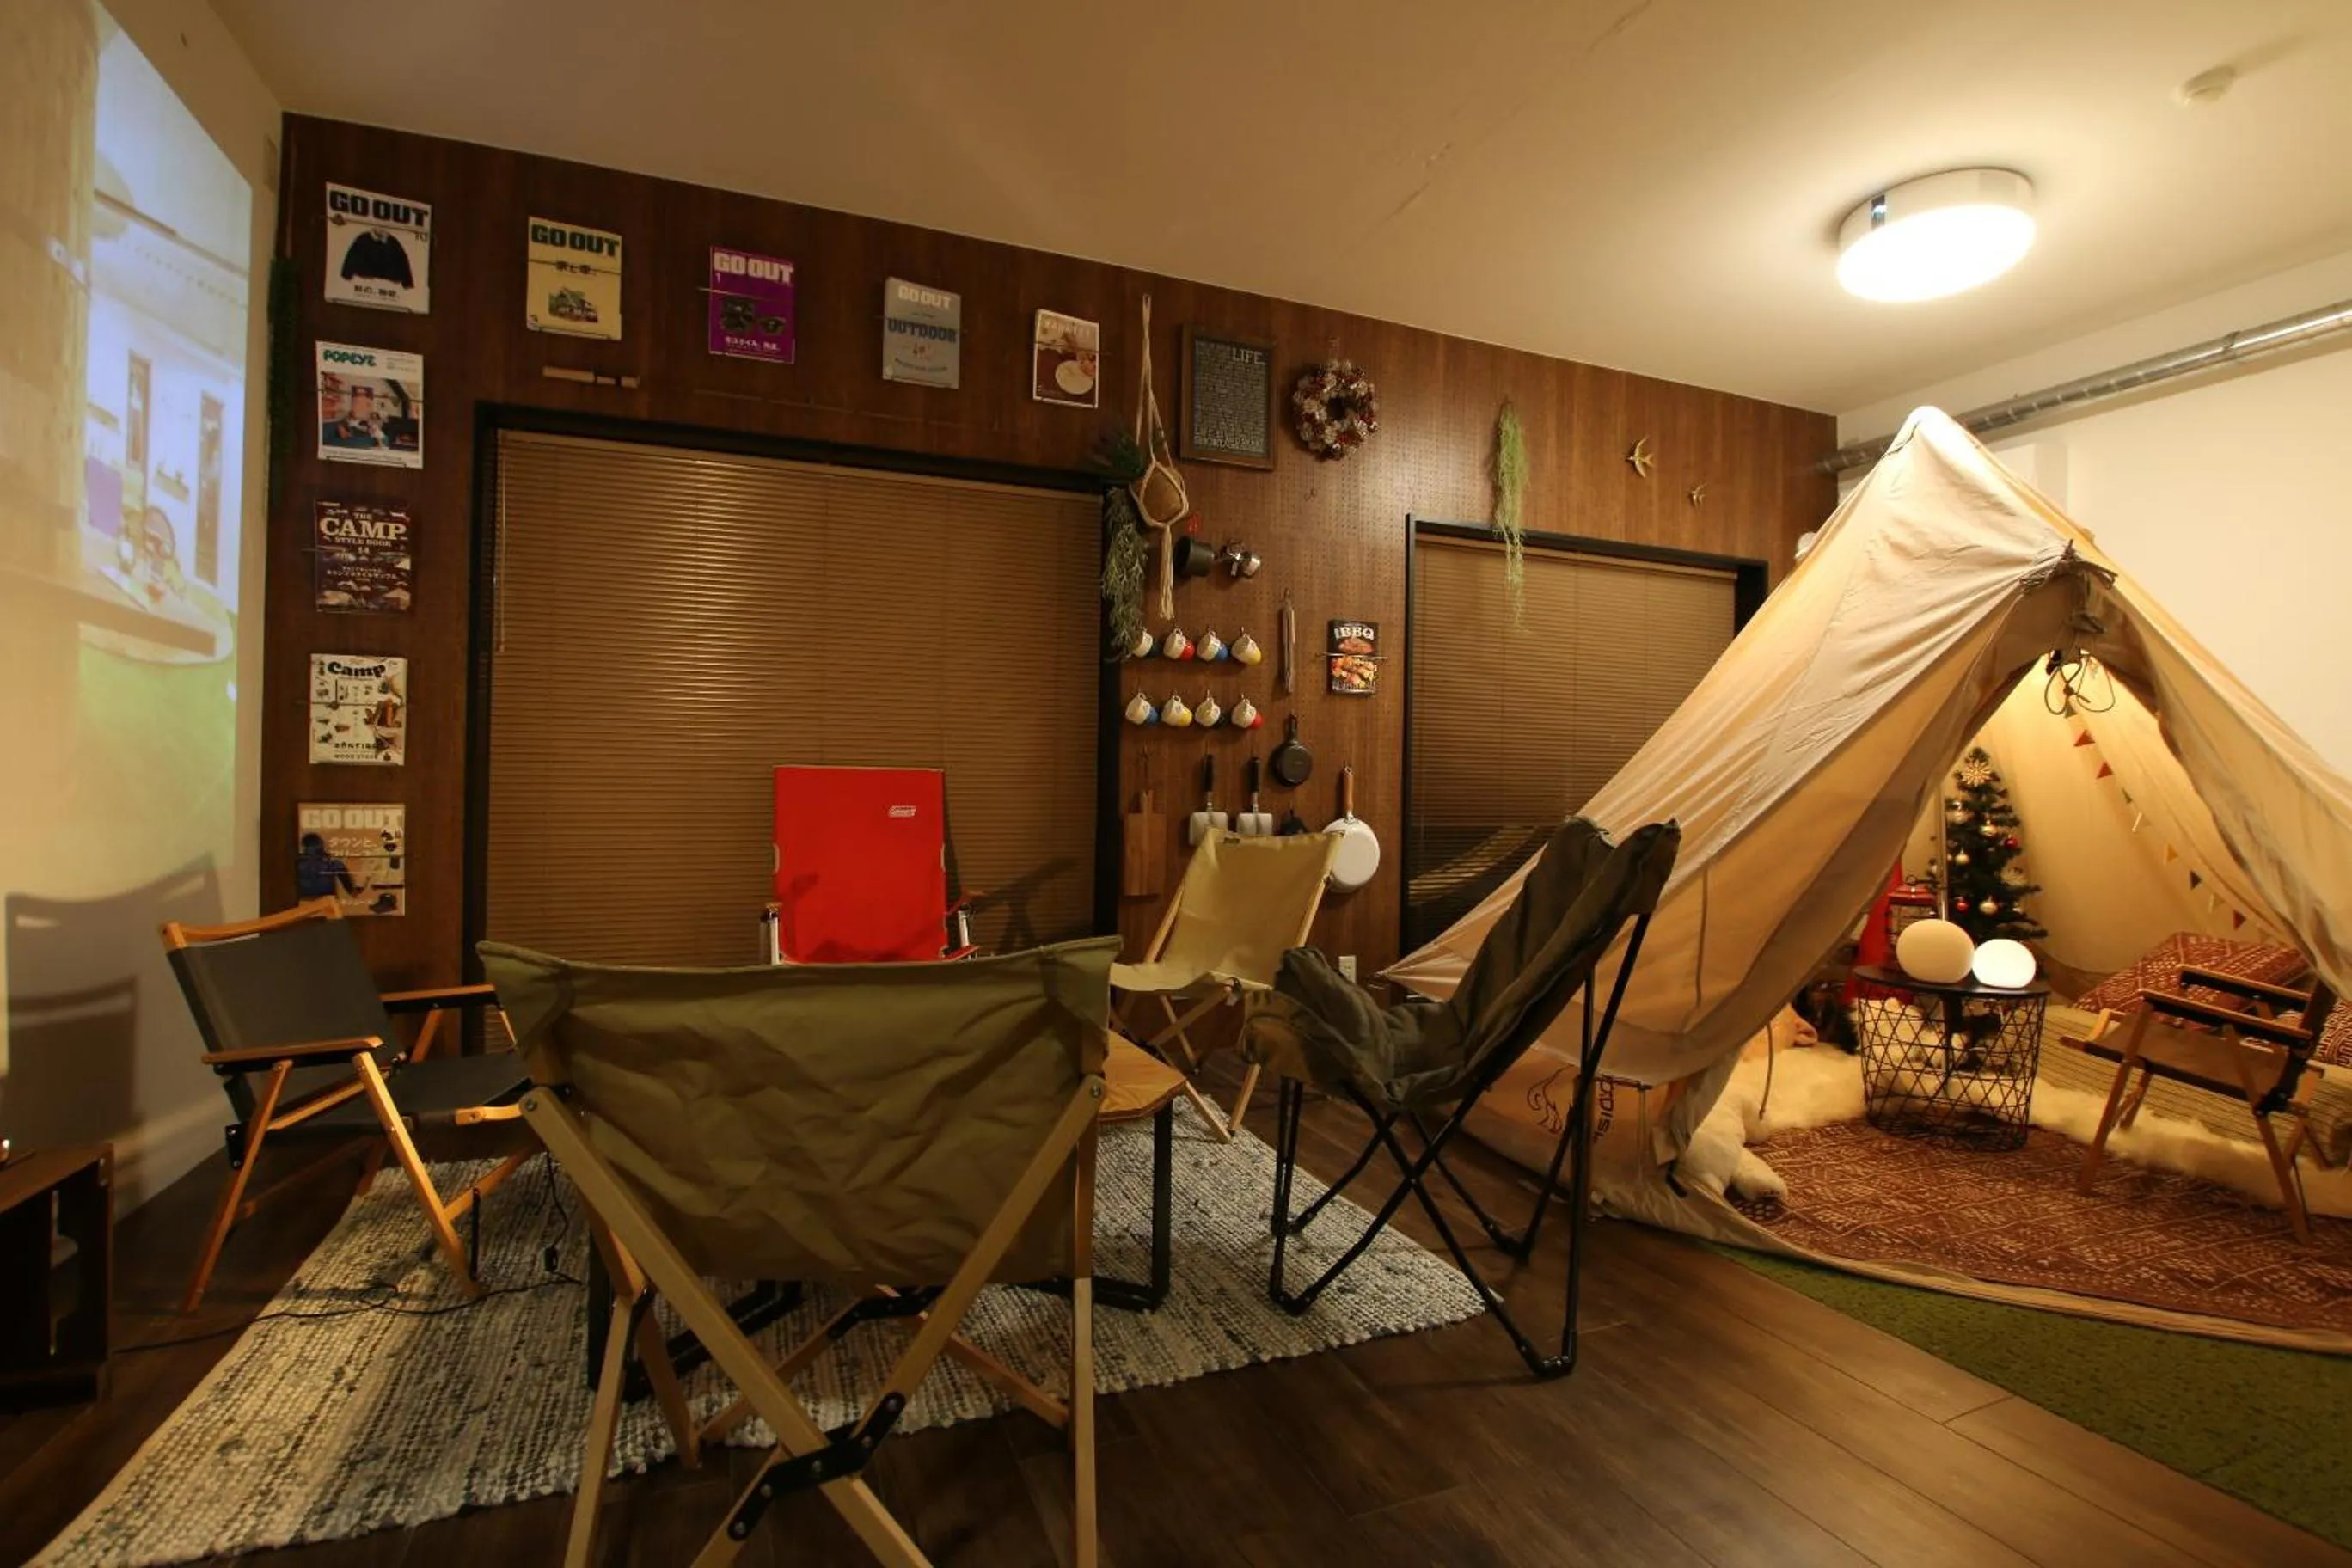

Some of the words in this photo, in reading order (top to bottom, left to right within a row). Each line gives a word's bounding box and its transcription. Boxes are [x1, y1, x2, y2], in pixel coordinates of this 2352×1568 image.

[329, 190, 370, 217] GO
[372, 204, 429, 226] OUT
[531, 224, 567, 247] GO
[569, 231, 620, 257] OUT
[714, 251, 745, 274] GO
[747, 258, 794, 285] OUT
[897, 285, 919, 303] GO
[920, 291, 952, 309] OUT
[887, 317, 956, 343] OUTDOOR
[322, 349, 377, 367] POPEYE
[319, 517, 407, 540] CAMP
[334, 536, 364, 545] STYLE
[327, 661, 386, 678] Camp
[300, 808, 342, 829] GO
[343, 808, 404, 830] OUT
